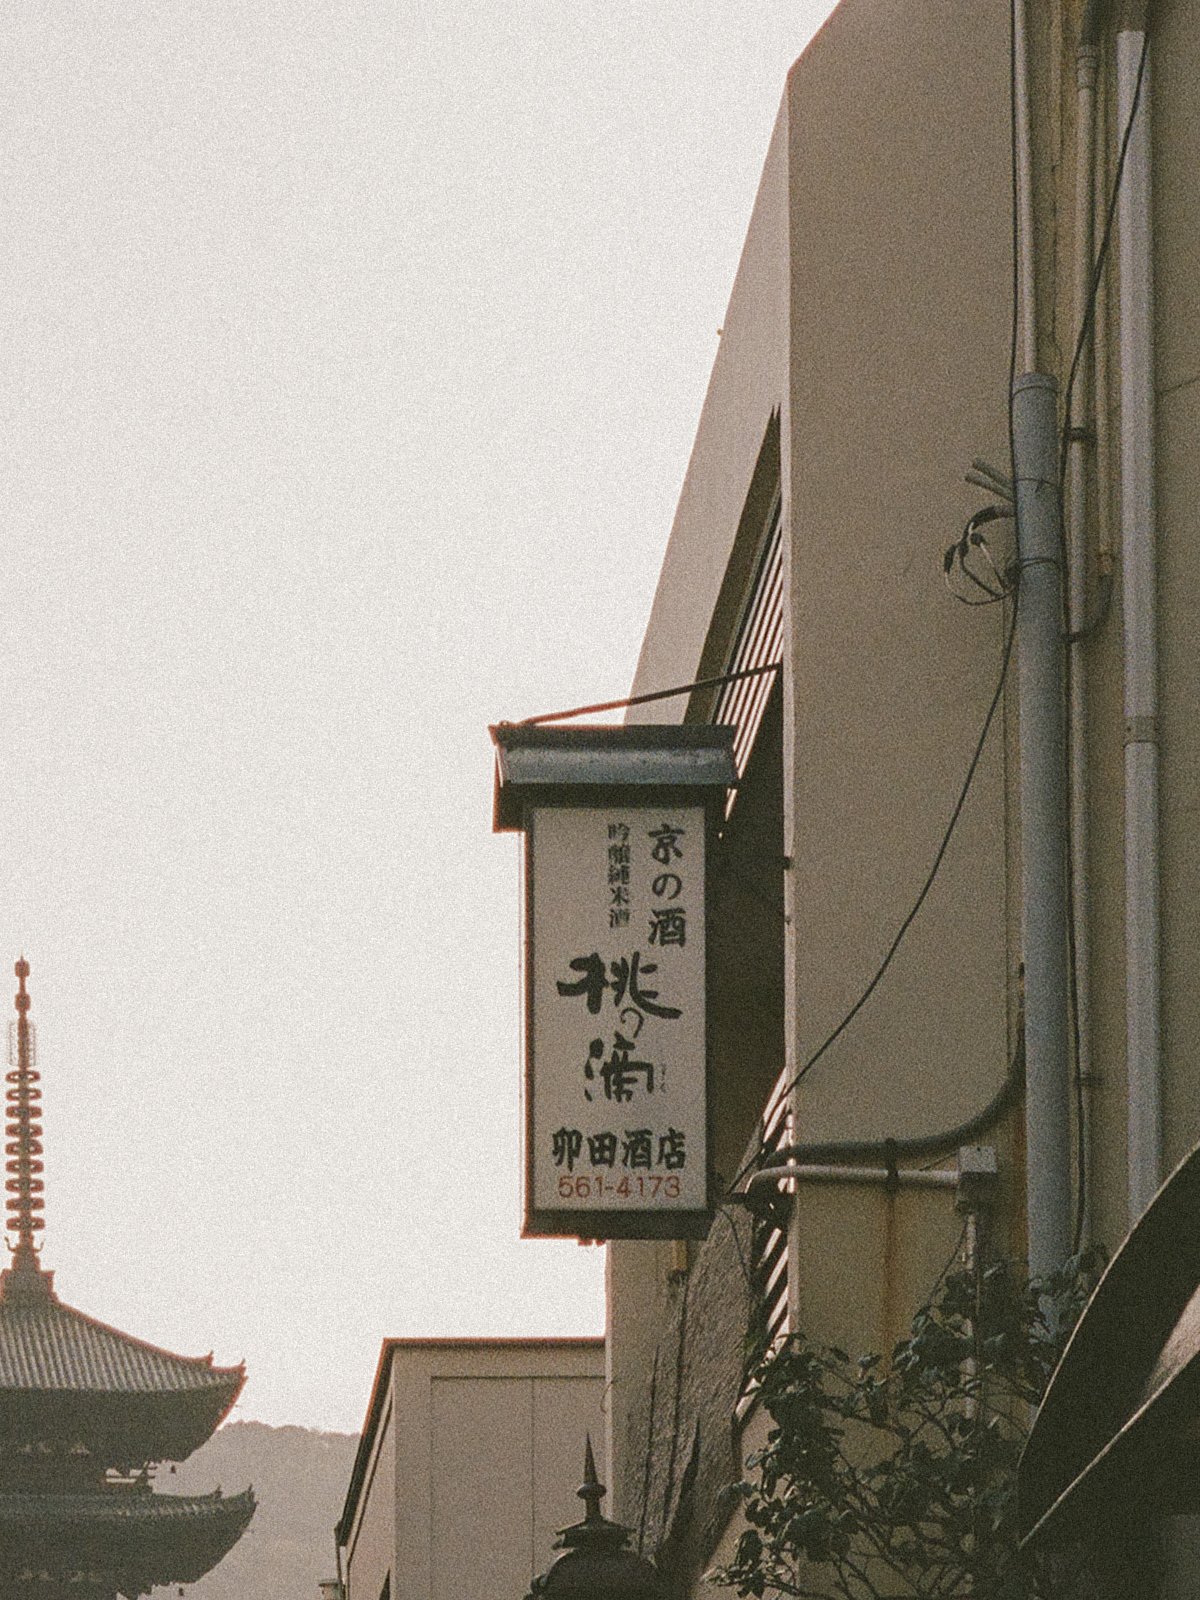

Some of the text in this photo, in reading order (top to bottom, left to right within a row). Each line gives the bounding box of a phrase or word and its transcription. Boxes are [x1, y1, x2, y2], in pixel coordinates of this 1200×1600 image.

[648, 823, 686, 947] 京の酒
[558, 1176, 681, 1198] 561-4173
